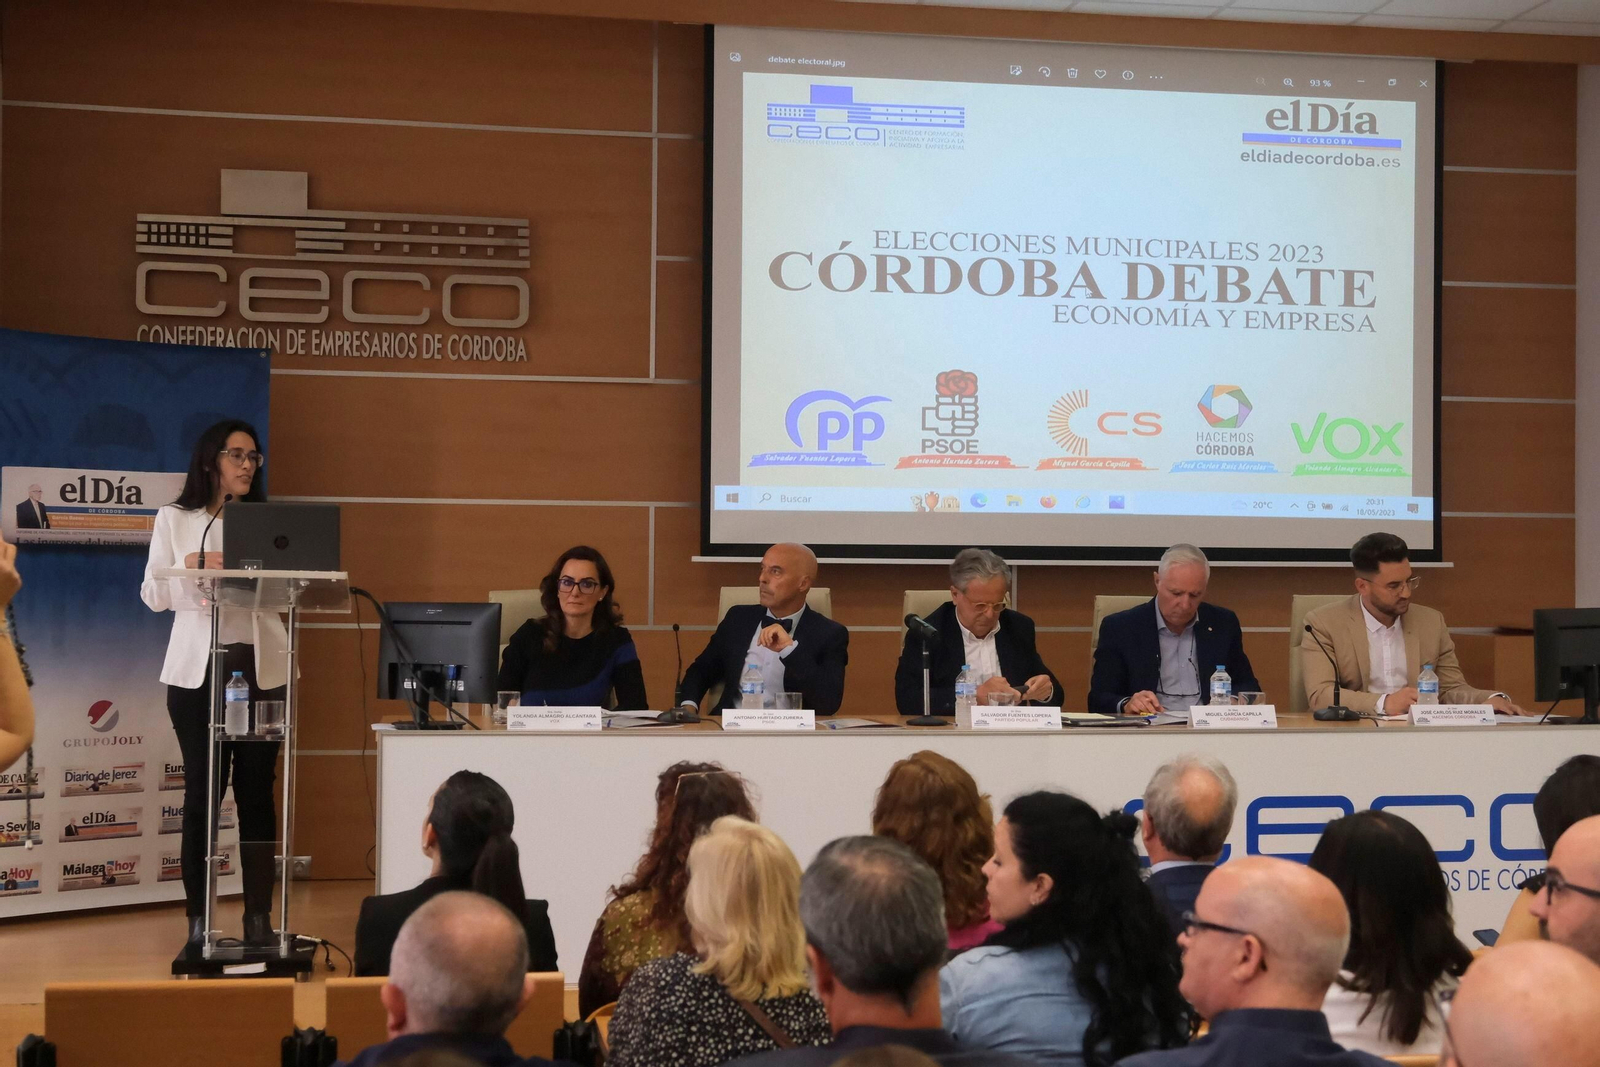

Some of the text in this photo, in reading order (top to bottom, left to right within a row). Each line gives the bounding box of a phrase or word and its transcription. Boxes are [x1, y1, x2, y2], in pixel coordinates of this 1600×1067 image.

[768, 55, 846, 68] debate electoral.jpg
[1310, 79, 1321, 87] 93
[1240, 150, 1401, 168] eldiadecordoba.es
[873, 230, 1324, 264] ELECCIONES MUNICIPALES 2023
[768, 241, 1377, 309] CÓRDOBA DEBATE
[1053, 303, 1377, 333] ECONOMÍA Y EMPRESA
[286, 329, 306, 356] DE
[311, 330, 417, 360] EMPRESARIOS
[423, 334, 442, 360] DE
[448, 335, 528, 362] CORDOBA
[1196, 431, 1254, 444] HACEMOS
[921, 439, 979, 454] PSOE
[1196, 443, 1255, 457] CÓRDOBA
[764, 454, 797, 463] Salvador
[911, 457, 942, 465] Antonio
[943, 458, 973, 466] Hurtado
[1053, 459, 1078, 467] Miguel
[1105, 460, 1131, 469] Capilla
[780, 494, 812, 504] Buscar
[1252, 501, 1273, 509] 20°C
[1366, 498, 1384, 506] 20:31
[1356, 508, 1396, 517] 18/05/2023
[64, 769, 137, 783] Diario de Jerez
[62, 860, 136, 877] Málaga hoy
[1468, 869, 1490, 891] DE
